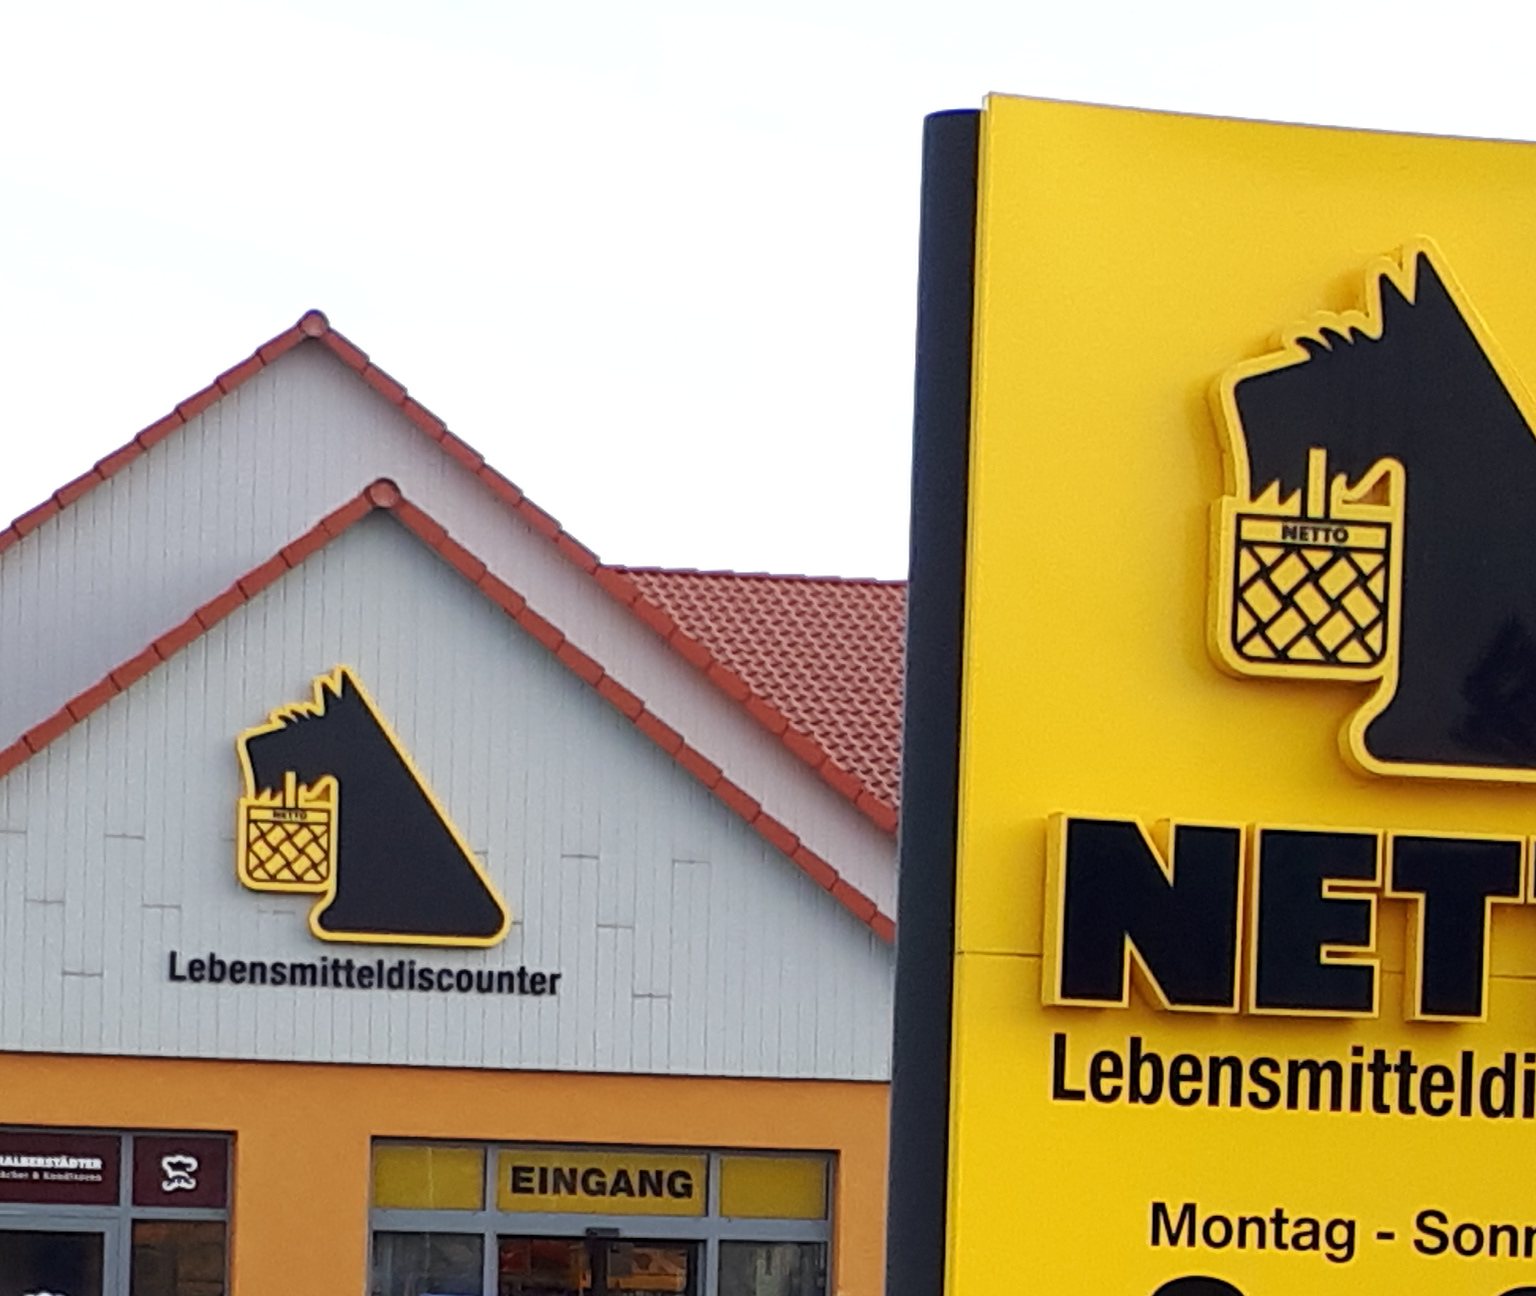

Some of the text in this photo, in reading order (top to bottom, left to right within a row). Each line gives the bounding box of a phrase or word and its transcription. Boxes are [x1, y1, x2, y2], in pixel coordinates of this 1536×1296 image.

[1282, 523, 1349, 543] NETTO
[168, 951, 562, 996] Lebensmitteldiscounter
[510, 1165, 694, 1199] EINGANG
[1149, 1202, 1356, 1263] Montag
